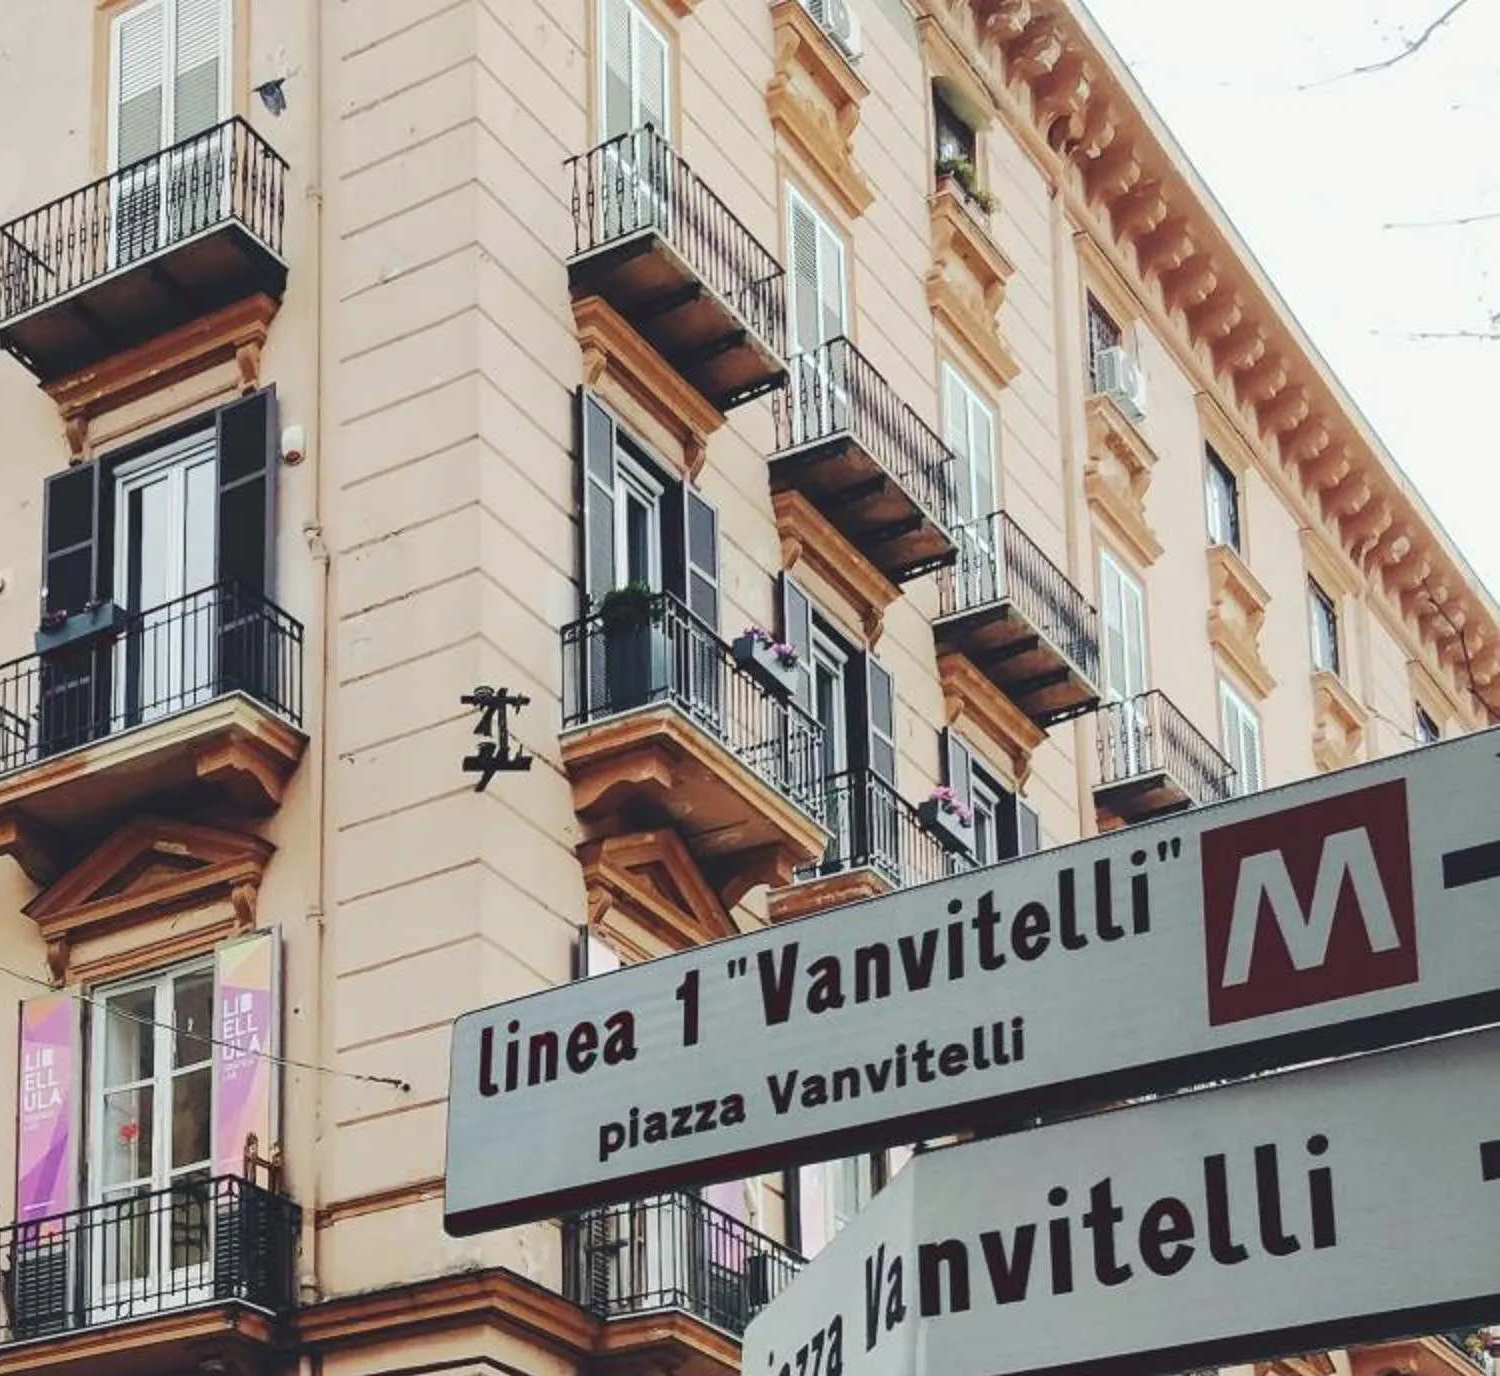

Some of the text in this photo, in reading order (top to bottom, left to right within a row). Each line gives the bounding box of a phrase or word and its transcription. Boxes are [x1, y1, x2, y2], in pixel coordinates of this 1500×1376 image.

[1221, 826, 1400, 988] M
[479, 837, 1181, 1098] linea 1 "Vanvitelli"
[223, 1034, 261, 1060] ULA
[224, 1013, 260, 1040] ELL
[24, 1088, 63, 1111] ULA
[25, 1068, 60, 1091] ELL
[599, 1016, 1025, 1163] piazza Vanvitelli
[865, 1133, 1338, 1352] Vanvitelli
